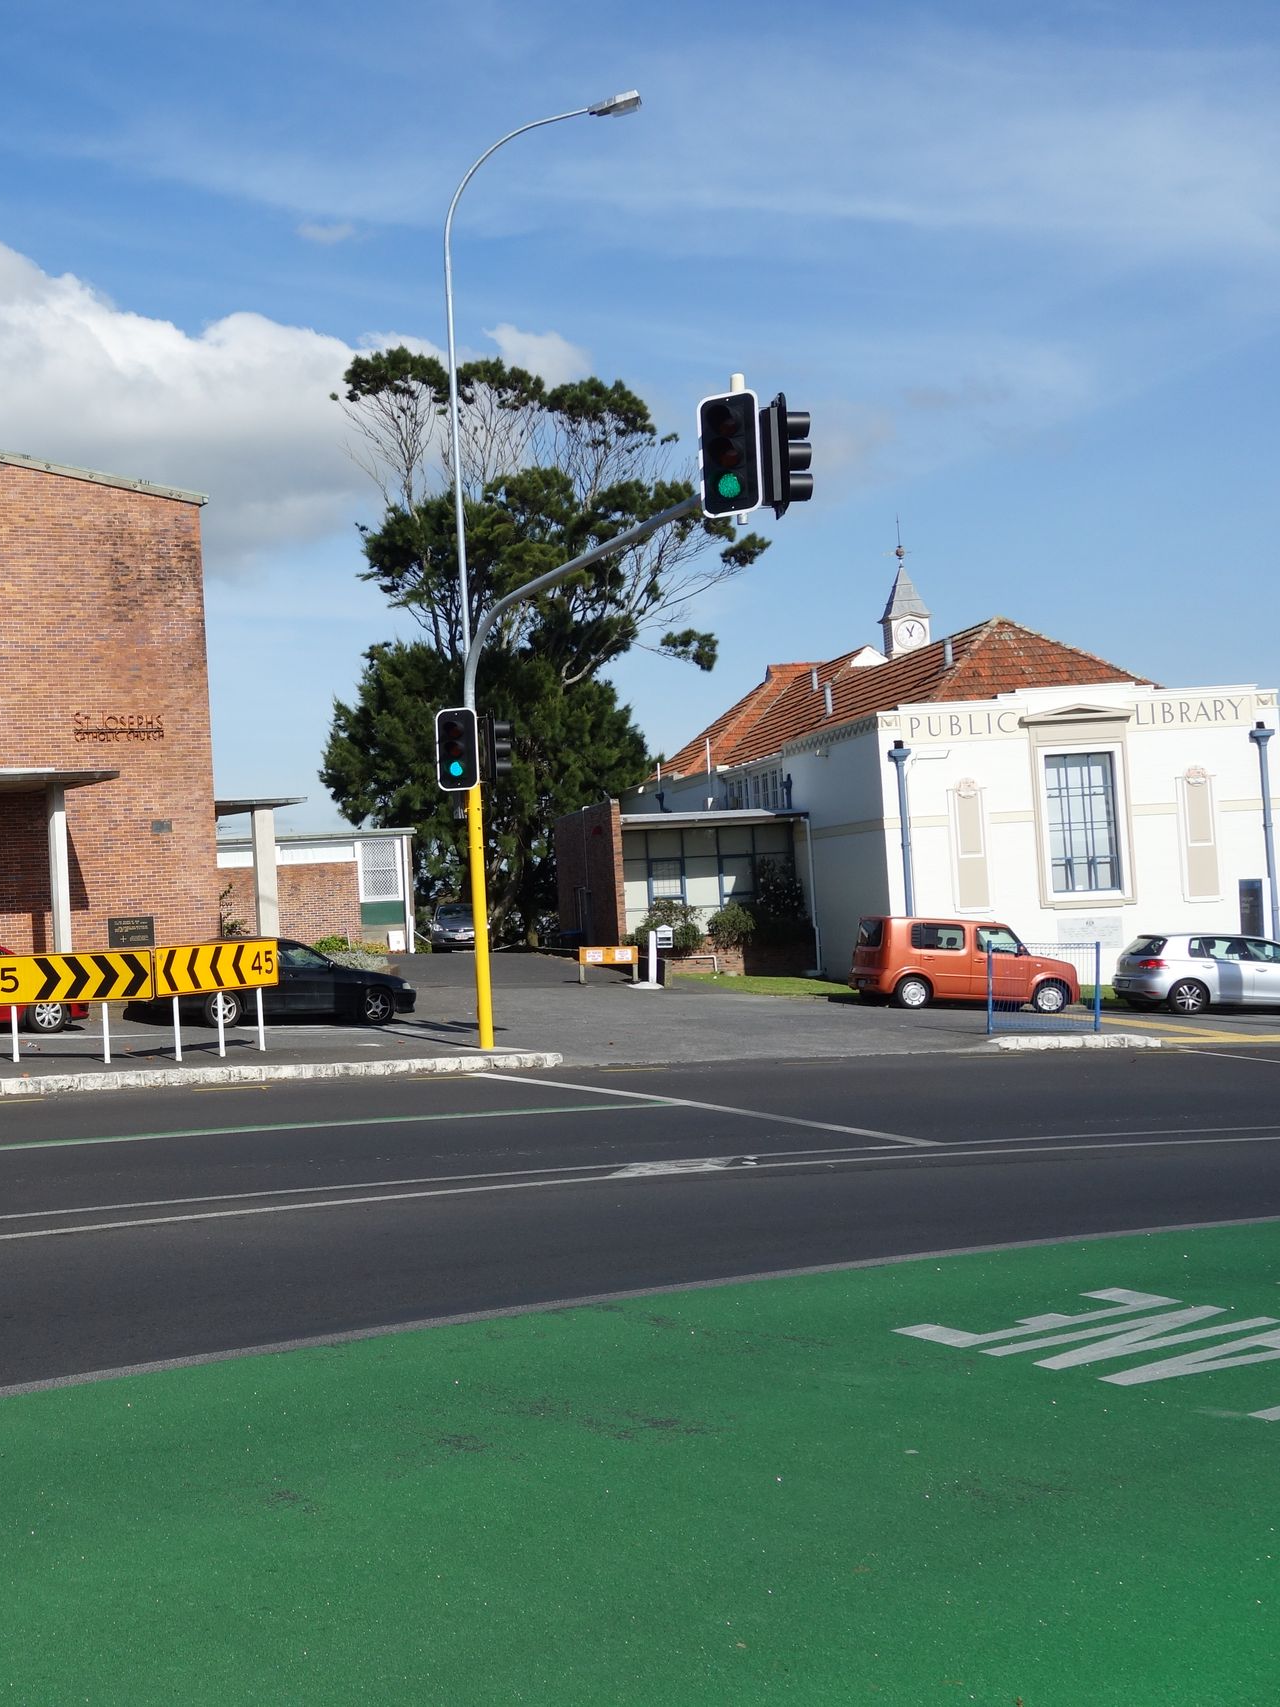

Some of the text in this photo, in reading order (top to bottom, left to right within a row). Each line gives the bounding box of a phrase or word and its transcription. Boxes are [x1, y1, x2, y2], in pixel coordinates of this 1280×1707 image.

[910, 697, 1245, 738] PUBLIC LIBRARY
[251, 950, 273, 975] 45
